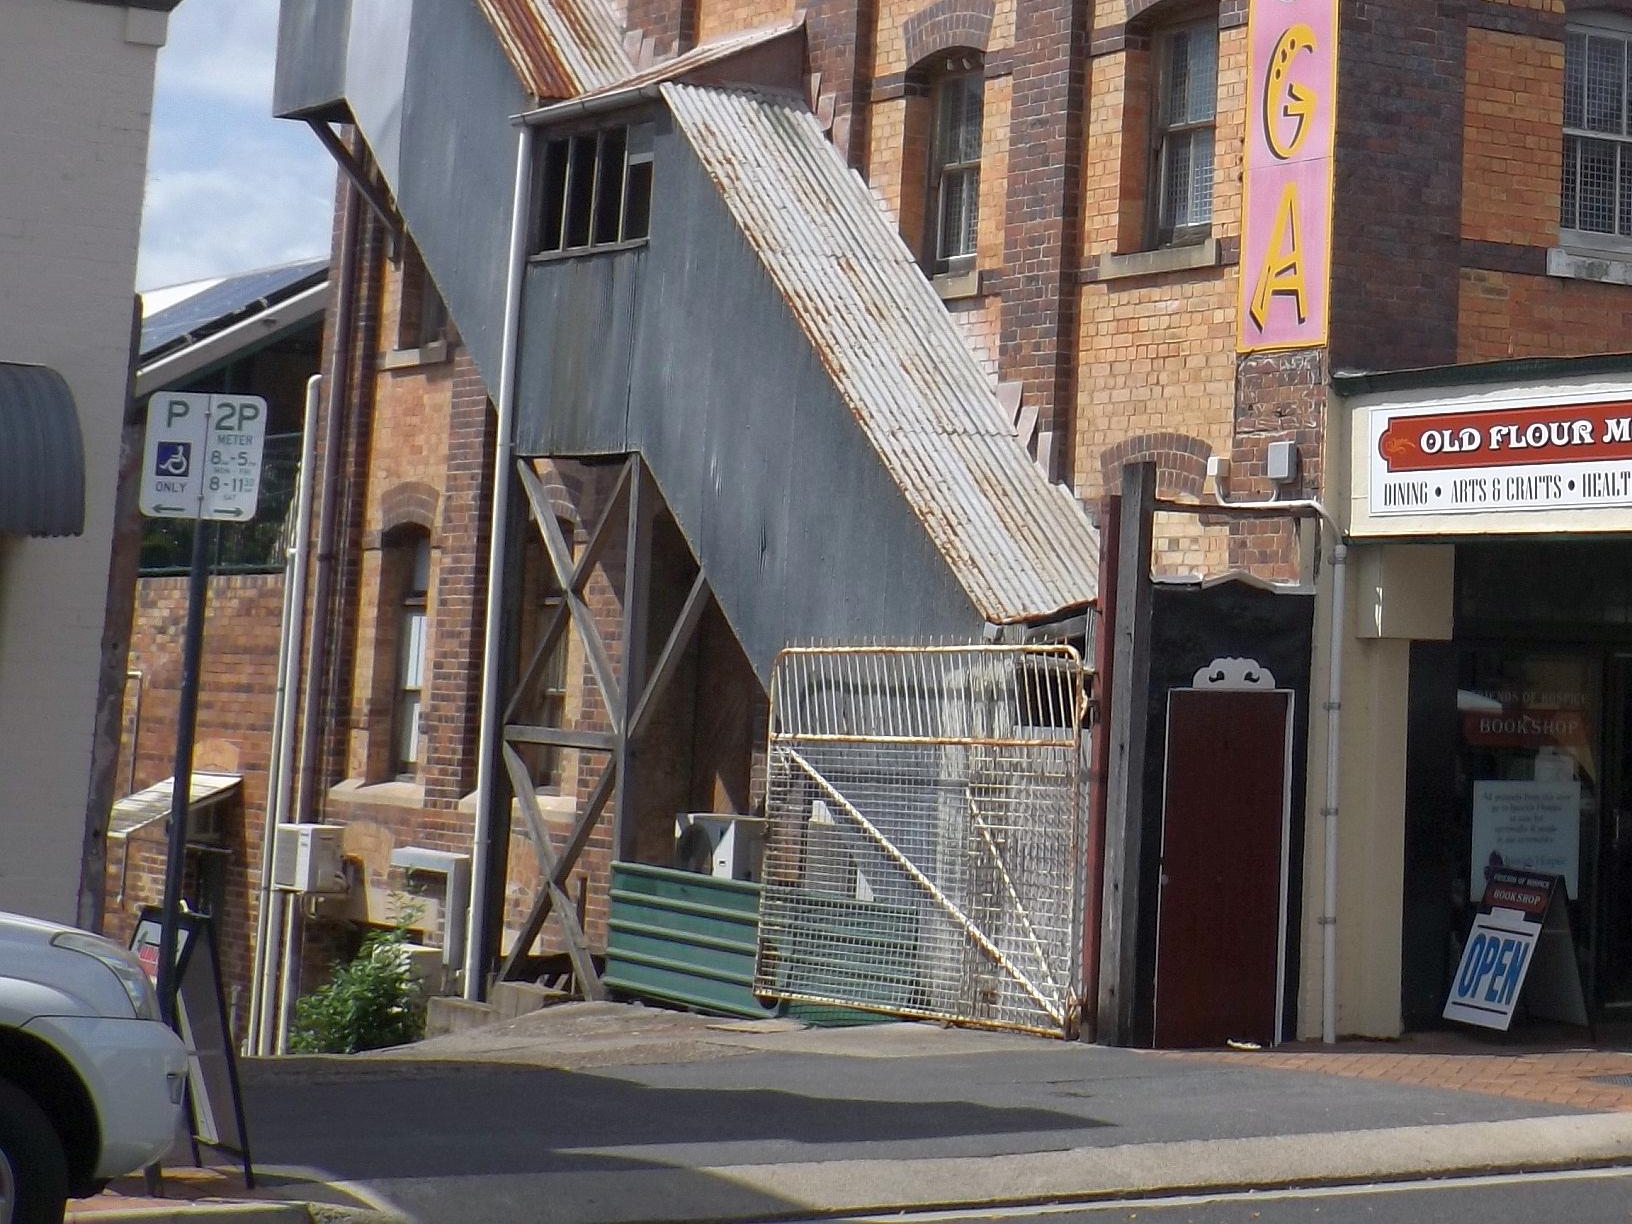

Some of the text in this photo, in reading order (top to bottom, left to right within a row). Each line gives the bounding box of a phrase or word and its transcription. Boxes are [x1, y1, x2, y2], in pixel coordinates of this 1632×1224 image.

[167, 400, 190, 428] P
[215, 402, 259, 431] 2P
[217, 434, 253, 445] METER
[1420, 429, 1481, 454] OLD
[1489, 421, 1593, 449] FLOUR
[155, 481, 188, 493] ONLY
[1384, 480, 1429, 507] DINING
[1450, 477, 1487, 504] ARTS
[1492, 478, 1501, 502] &
[1506, 474, 1562, 501] CRAFTS
[1458, 933, 1530, 1005] OPEN
